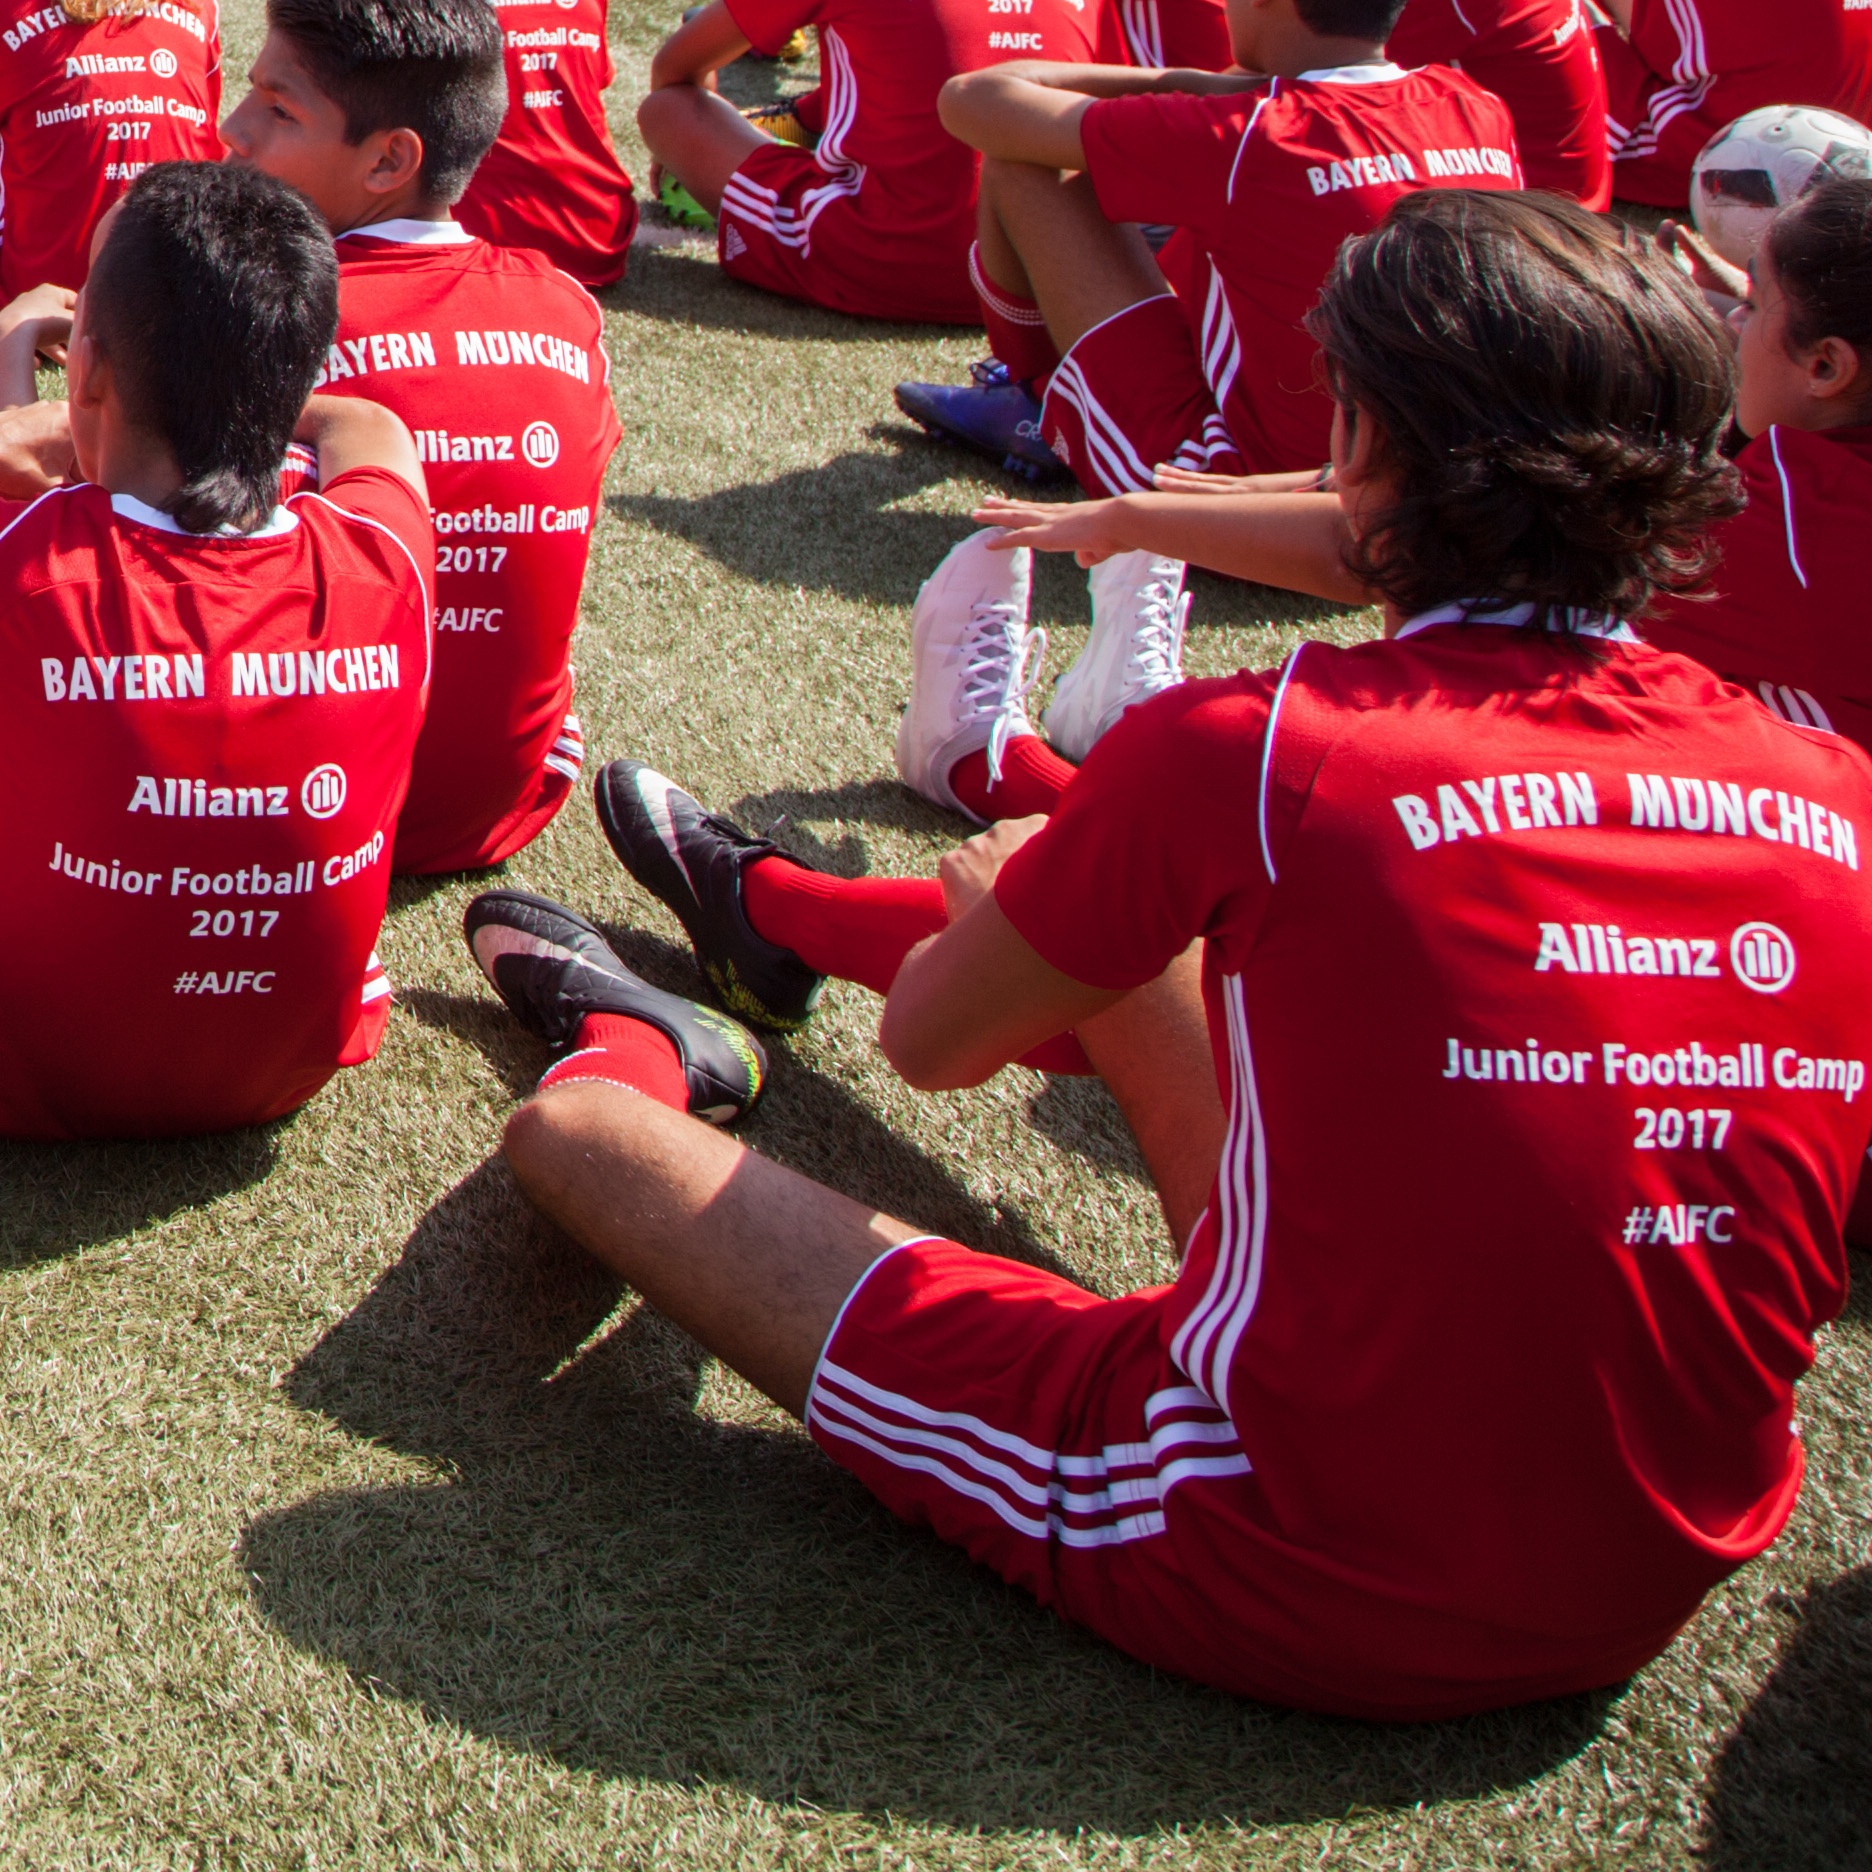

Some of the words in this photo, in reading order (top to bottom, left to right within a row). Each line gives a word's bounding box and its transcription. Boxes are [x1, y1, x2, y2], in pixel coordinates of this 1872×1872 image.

[506, 28, 568, 48] Football
[569, 30, 601, 53] Camp
[988, 31, 1044, 52] #AJFC
[65, 53, 147, 80] Allianz
[519, 52, 558, 72] 2017
[34, 102, 89, 129] Junior
[91, 94, 165, 117] Football
[166, 98, 207, 127] Camp
[522, 89, 564, 109] #AJFC
[106, 121, 152, 142] 2017
[1306, 152, 1416, 198] BAYERN
[454, 330, 590, 386] MÜNCHEN
[539, 504, 591, 537] Camp
[434, 545, 508, 575] 2017
[40, 651, 206, 703] BAYERN
[230, 644, 400, 698] MÜNCHEN
[127, 775, 290, 819] Allianz
[1392, 771, 1599, 852] BAYERN
[1625, 772, 1860, 872] MÜNCHEN
[48, 841, 162, 897] Junior
[169, 859, 315, 897] Football
[322, 830, 385, 888] Camp
[188, 909, 280, 938] 2017
[1533, 921, 1721, 978] Allianz
[172, 970, 277, 996] #AJFC
[1442, 1037, 1593, 1084] Junior
[1601, 1039, 1766, 1089] Football
[1772, 1045, 1866, 1104] Camp
[1632, 1107, 1733, 1152] 2017
[1621, 1203, 1736, 1247] #AJFC
